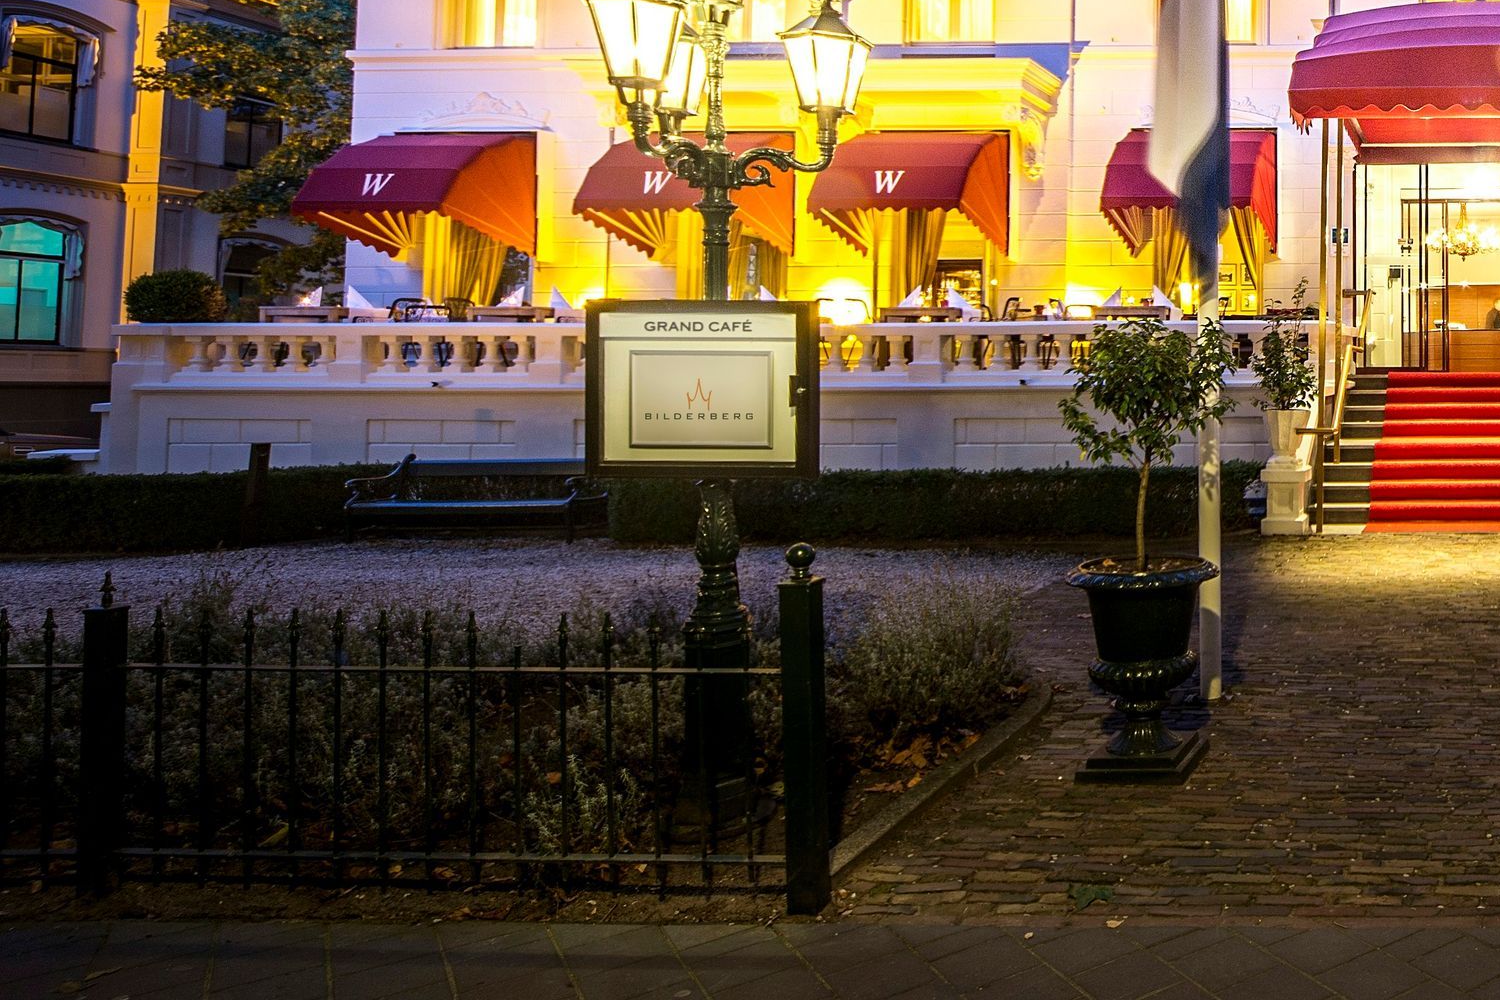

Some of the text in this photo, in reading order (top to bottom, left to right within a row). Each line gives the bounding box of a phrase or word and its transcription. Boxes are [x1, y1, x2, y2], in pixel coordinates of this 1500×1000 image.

[361, 173, 396, 196] W
[643, 170, 674, 195] W
[873, 170, 906, 194] W
[643, 319, 753, 332] GRAND CAFÉ
[644, 412, 754, 420] BILDERBERG
